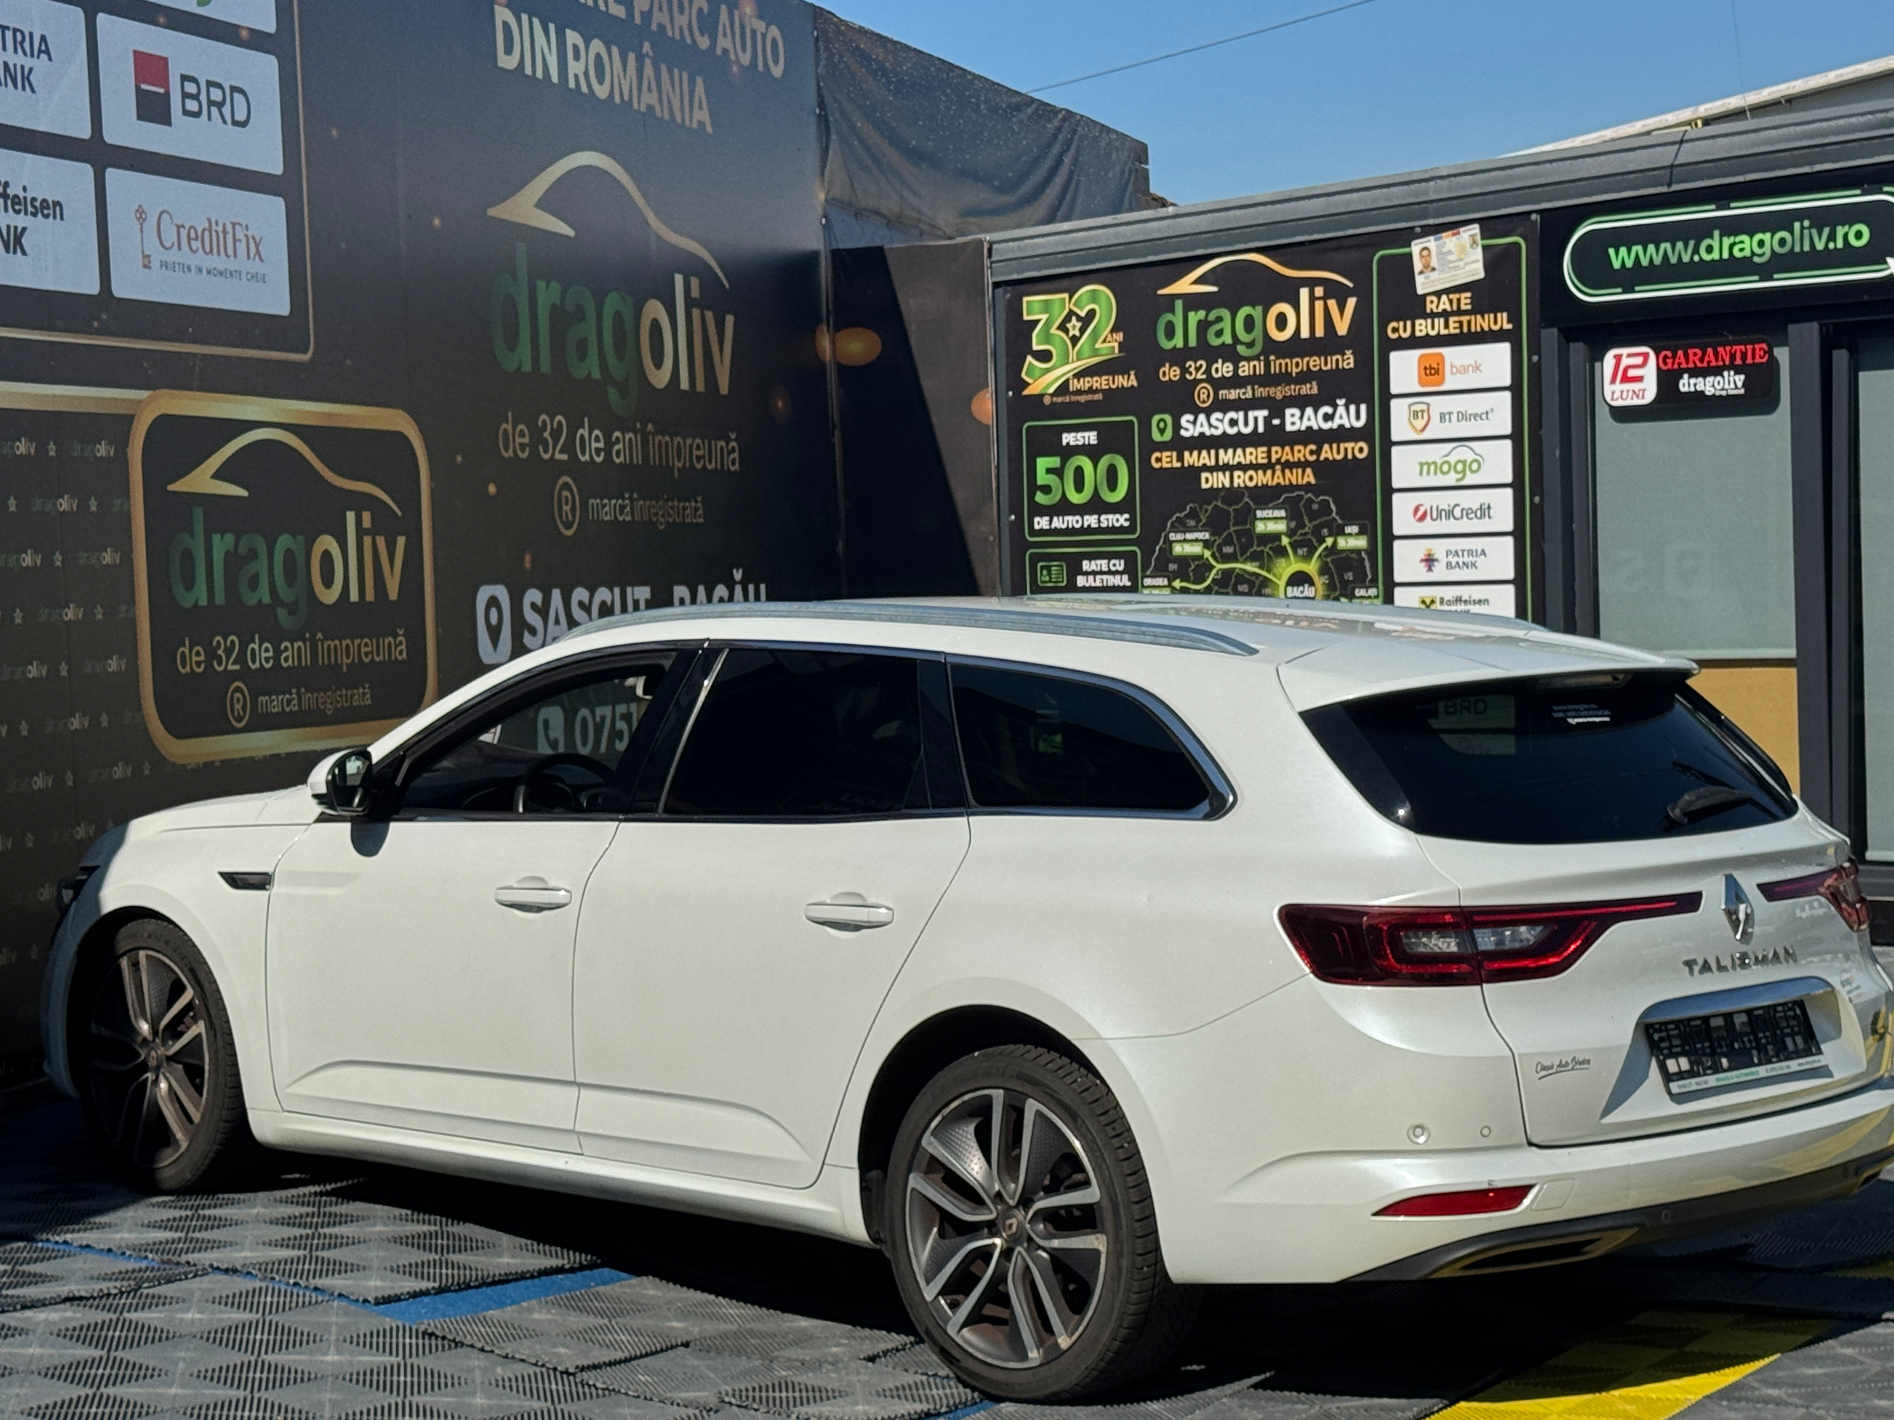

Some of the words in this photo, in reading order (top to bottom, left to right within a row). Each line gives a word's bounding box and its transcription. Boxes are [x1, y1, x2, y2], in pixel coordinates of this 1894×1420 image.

[716, 4, 785, 79] AUTO
[0, 60, 37, 95] NK
[493, 5, 559, 84] DIN
[565, 41, 713, 134] ROMÂNIA
[180, 73, 252, 129] BRD
[156, 209, 264, 263] CreditFix
[1608, 220, 1871, 270] www.dragoliv.ro
[159, 260, 192, 275] PRIETEN
[206, 267, 243, 281] MOMENTE
[245, 271, 267, 284] CHEIE
[1426, 292, 1472, 313] RATE
[490, 241, 734, 417] dragoliv
[1021, 284, 1117, 384] 32
[1156, 286, 1358, 357] dragoliv
[1387, 320, 1411, 339] CU
[1415, 312, 1513, 337] BULETINUL
[1106, 331, 1124, 342] ANI
[1159, 363, 1181, 381] de
[1185, 360, 1207, 379] 32
[1211, 358, 1234, 378] de
[1238, 355, 1265, 376] ani
[1269, 349, 1354, 377] împreună
[1423, 362, 1440, 377] tbi
[1450, 360, 1482, 376] bank
[1609, 352, 1650, 385] 12
[1658, 343, 1769, 370] GARANTIE
[1069, 370, 1138, 392] ÎMPREUNĂ
[1218, 383, 1253, 400] marcă
[1254, 381, 1318, 400] înregistrată
[1610, 388, 1646, 401] LUNI
[1679, 370, 1745, 396] dragoliv
[1180, 409, 1269, 437] SASCUT
[1284, 398, 1368, 432] BACĂU
[1412, 409, 1425, 420] BT
[1439, 412, 1453, 423] BT
[499, 411, 529, 459] de
[538, 414, 568, 460] 32
[575, 417, 605, 463] de
[612, 422, 642, 465] ani
[646, 422, 740, 478] împreună
[1062, 431, 1098, 446] PESTE
[1150, 451, 1181, 469] CEL
[1184, 450, 1215, 467] MAI
[1219, 446, 1268, 466] MARE
[1271, 444, 1317, 463] PARC
[1320, 441, 1369, 460] AUTO
[1034, 453, 1129, 505] 500
[1200, 470, 1230, 489] DIN
[1233, 466, 1316, 487] ROMÂNIA
[1418, 458, 1481, 482] mogo
[588, 492, 632, 521] marcă
[633, 493, 704, 529] înregistrată
[1034, 516, 1050, 530] DE
[1051, 515, 1082, 529] AUTO
[1084, 515, 1098, 528] PE
[1100, 514, 1130, 527] STOC
[1430, 503, 1492, 521] UniCredit
[1082, 560, 1108, 572] RATE
[1109, 559, 1124, 571] CU
[1445, 549, 1487, 559] PATRIA
[1445, 561, 1478, 571] BANK
[169, 507, 406, 630] dragoliv
[1077, 574, 1131, 587] BULETINUL
[1439, 595, 1490, 607] Raiffeisen
[177, 637, 206, 674] de
[212, 635, 241, 671] 32
[247, 634, 274, 669] de
[280, 633, 311, 667] ani
[316, 628, 407, 672] împreună
[257, 688, 299, 713] marcă
[301, 683, 371, 714] înregistrată
[1682, 944, 1798, 977] TALISMAN
